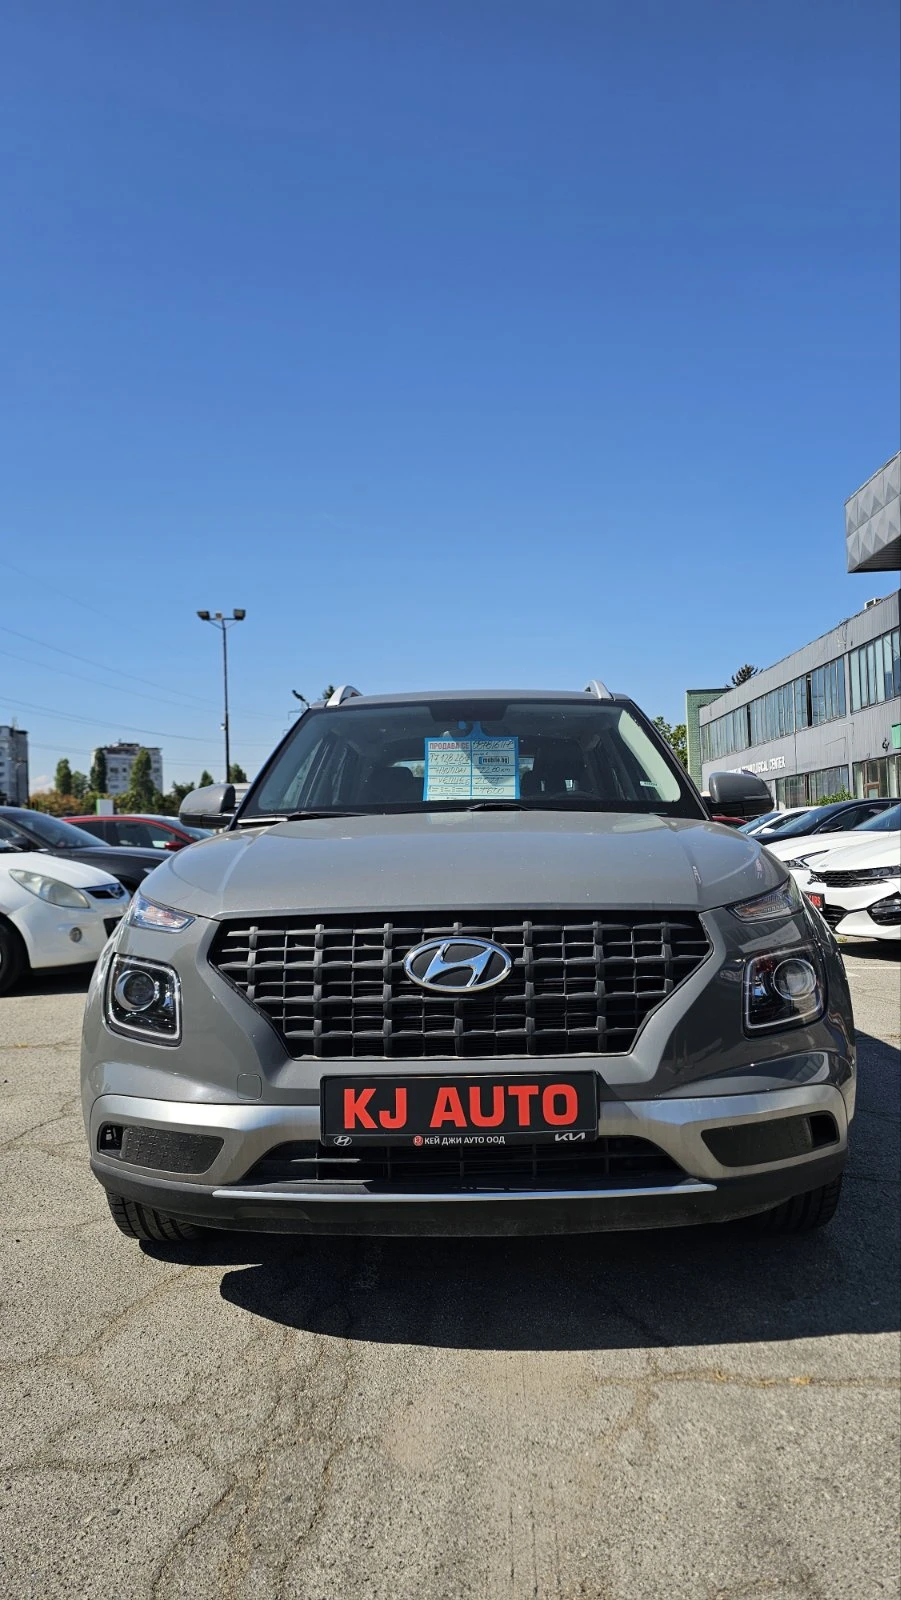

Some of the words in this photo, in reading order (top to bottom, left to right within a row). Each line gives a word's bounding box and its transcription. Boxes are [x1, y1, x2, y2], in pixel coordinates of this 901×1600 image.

[344, 1087, 407, 1129] KJ
[429, 1083, 578, 1128] AUTO
[424, 1135, 440, 1145] КЕЙ
[441, 1136, 462, 1146] ДЖИ
[463, 1136, 485, 1144] АУТО
[486, 1135, 506, 1145] ООД
